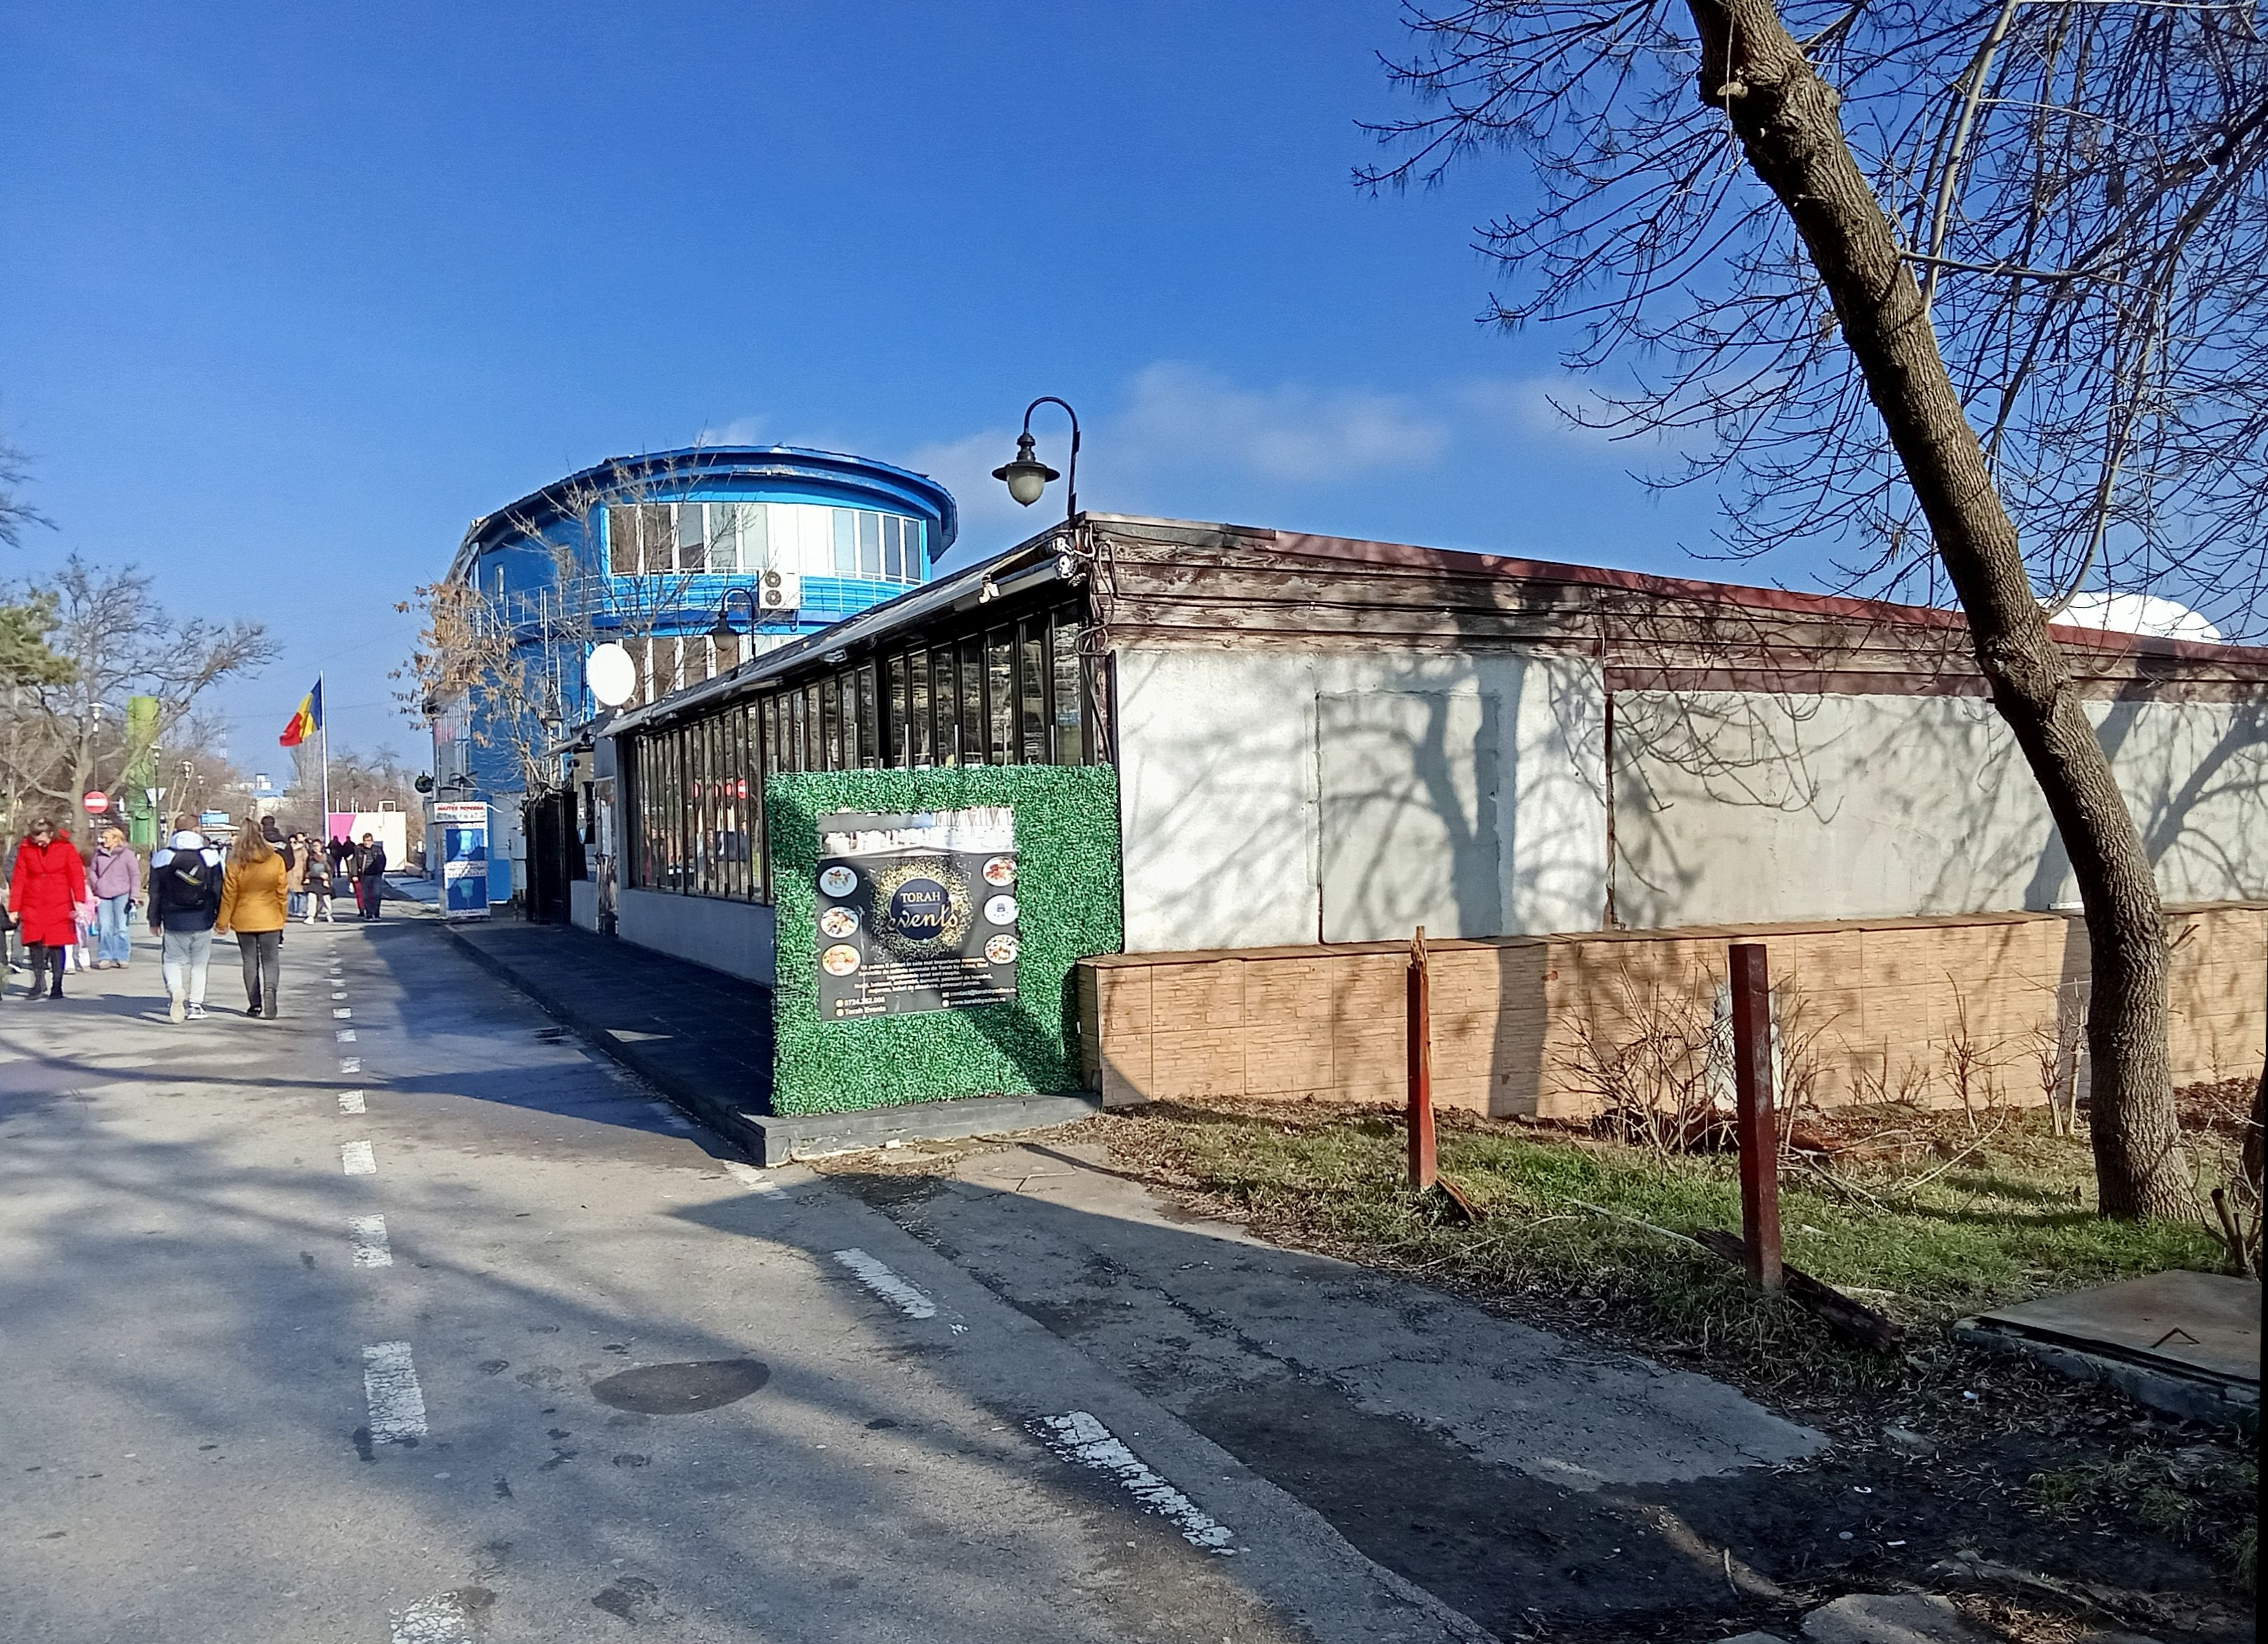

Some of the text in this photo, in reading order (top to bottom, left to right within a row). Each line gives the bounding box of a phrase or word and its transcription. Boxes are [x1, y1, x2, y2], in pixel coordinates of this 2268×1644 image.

[900, 891, 940, 903] TORAH
[886, 904, 958, 931] events
[845, 1005, 887, 1015] Torah Events
